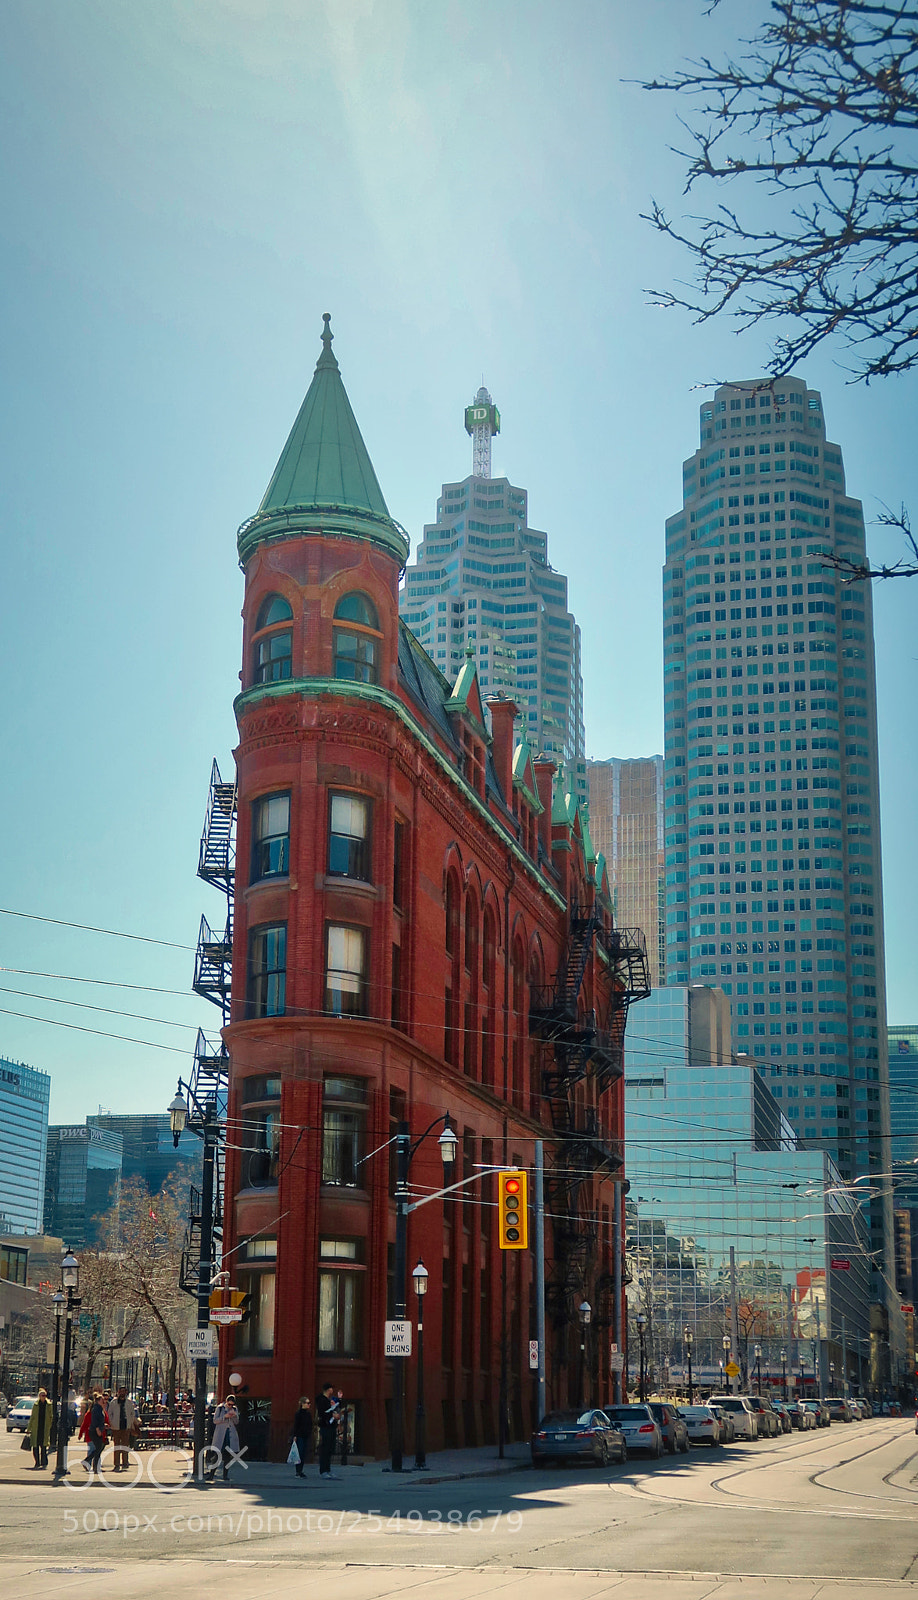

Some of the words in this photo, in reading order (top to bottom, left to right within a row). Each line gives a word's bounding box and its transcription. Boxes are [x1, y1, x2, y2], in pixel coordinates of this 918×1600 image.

[470, 408, 487, 420] TD
[59, 1128, 87, 1141] pwc
[391, 1324, 405, 1332] ONE
[195, 1332, 205, 1341] NO
[391, 1334, 405, 1342] WAY
[386, 1344, 410, 1353] BEGINS
